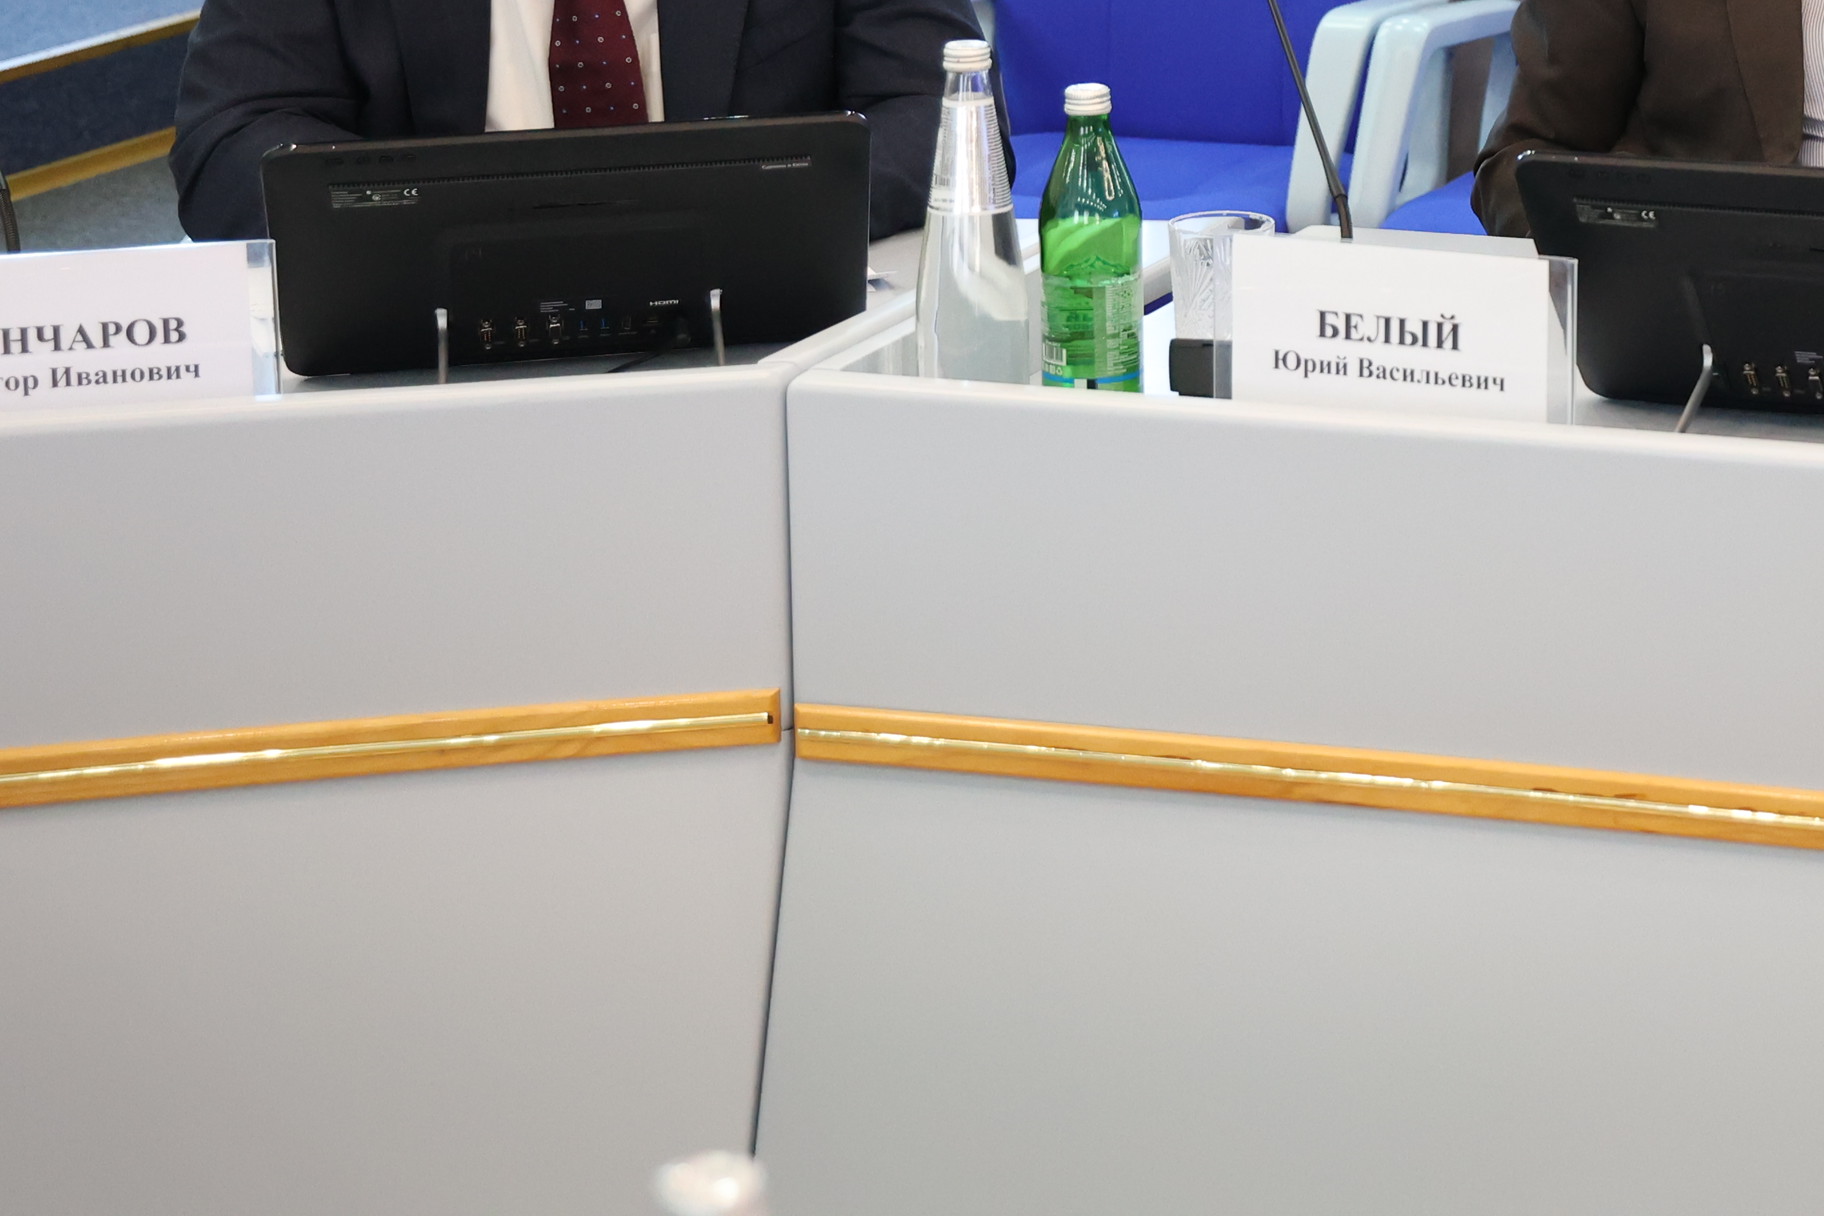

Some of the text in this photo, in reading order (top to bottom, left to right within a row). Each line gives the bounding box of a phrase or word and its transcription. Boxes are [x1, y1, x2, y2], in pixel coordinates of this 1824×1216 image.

[0, 316, 187, 355] НЧАРОВ
[1317, 309, 1461, 351] БЕЛЫЙ
[50, 363, 201, 388] Иванович
[1273, 349, 1505, 392] Юрий Васильевич
